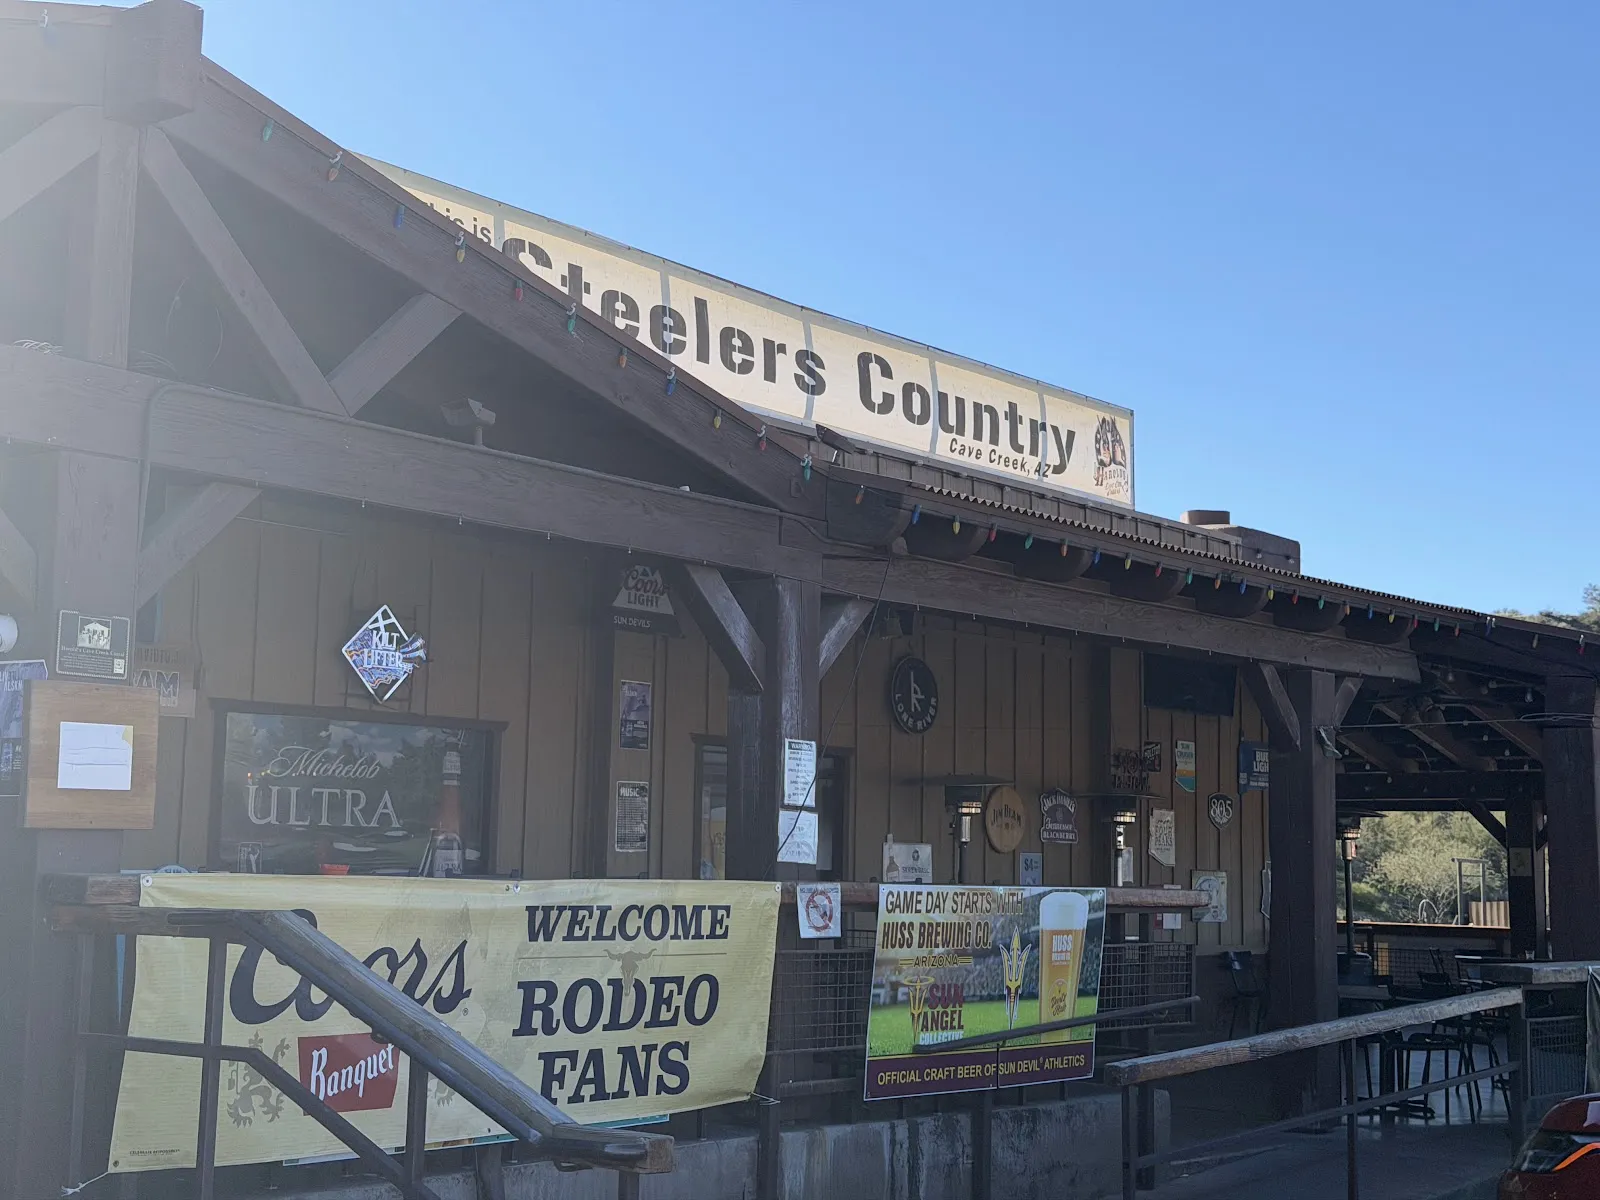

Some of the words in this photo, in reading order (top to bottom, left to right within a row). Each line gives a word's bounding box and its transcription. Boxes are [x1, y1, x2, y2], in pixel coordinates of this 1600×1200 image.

[857, 351, 1076, 475] Country
[949, 438, 982, 460] Cave
[988, 449, 1030, 477] Creek,
[1034, 462, 1051, 478] AZ
[627, 592, 660, 609] LIGHT
[614, 616, 628, 625] SUN
[629, 618, 651, 628] DEVILS
[372, 630, 400, 650] KILT
[363, 648, 404, 668] LIFTER
[895, 693, 914, 728] LONE
[917, 696, 937, 730] RIVER
[268, 746, 380, 779] Michelob
[1253, 761, 1269, 773] LIGH
[620, 787, 640, 797] MUSIC
[246, 785, 402, 828] ULTRA
[1210, 799, 1232, 818] 805
[1042, 830, 1076, 840] BLACKBERRY
[885, 890, 922, 914] GAME
[925, 891, 949, 914] DAY
[951, 891, 992, 914] STARTS
[996, 892, 1024, 915] WITH
[525, 904, 731, 942] WELCOME
[881, 921, 914, 949] HUSS
[917, 920, 972, 949] BREWING
[975, 921, 992, 949] CO.
[1052, 935, 1073, 952] HUSS
[913, 955, 959, 968] ARIZONA
[511, 973, 720, 1037] RODEO
[928, 983, 965, 1010] SUN
[921, 1009, 965, 1032] ANGEL
[919, 1031, 964, 1045] COLLECTIVE
[310, 1043, 395, 1101] Banquet
[537, 1040, 690, 1106] FANS
[877, 1069, 921, 1086] OFFICIAL
[924, 1066, 956, 1081] CRAFT
[957, 1064, 982, 1079] BEER
[984, 1063, 997, 1076] OF
[998, 1061, 1016, 1075] SUN
[1044, 1054, 1085, 1070] ATHLETICS
